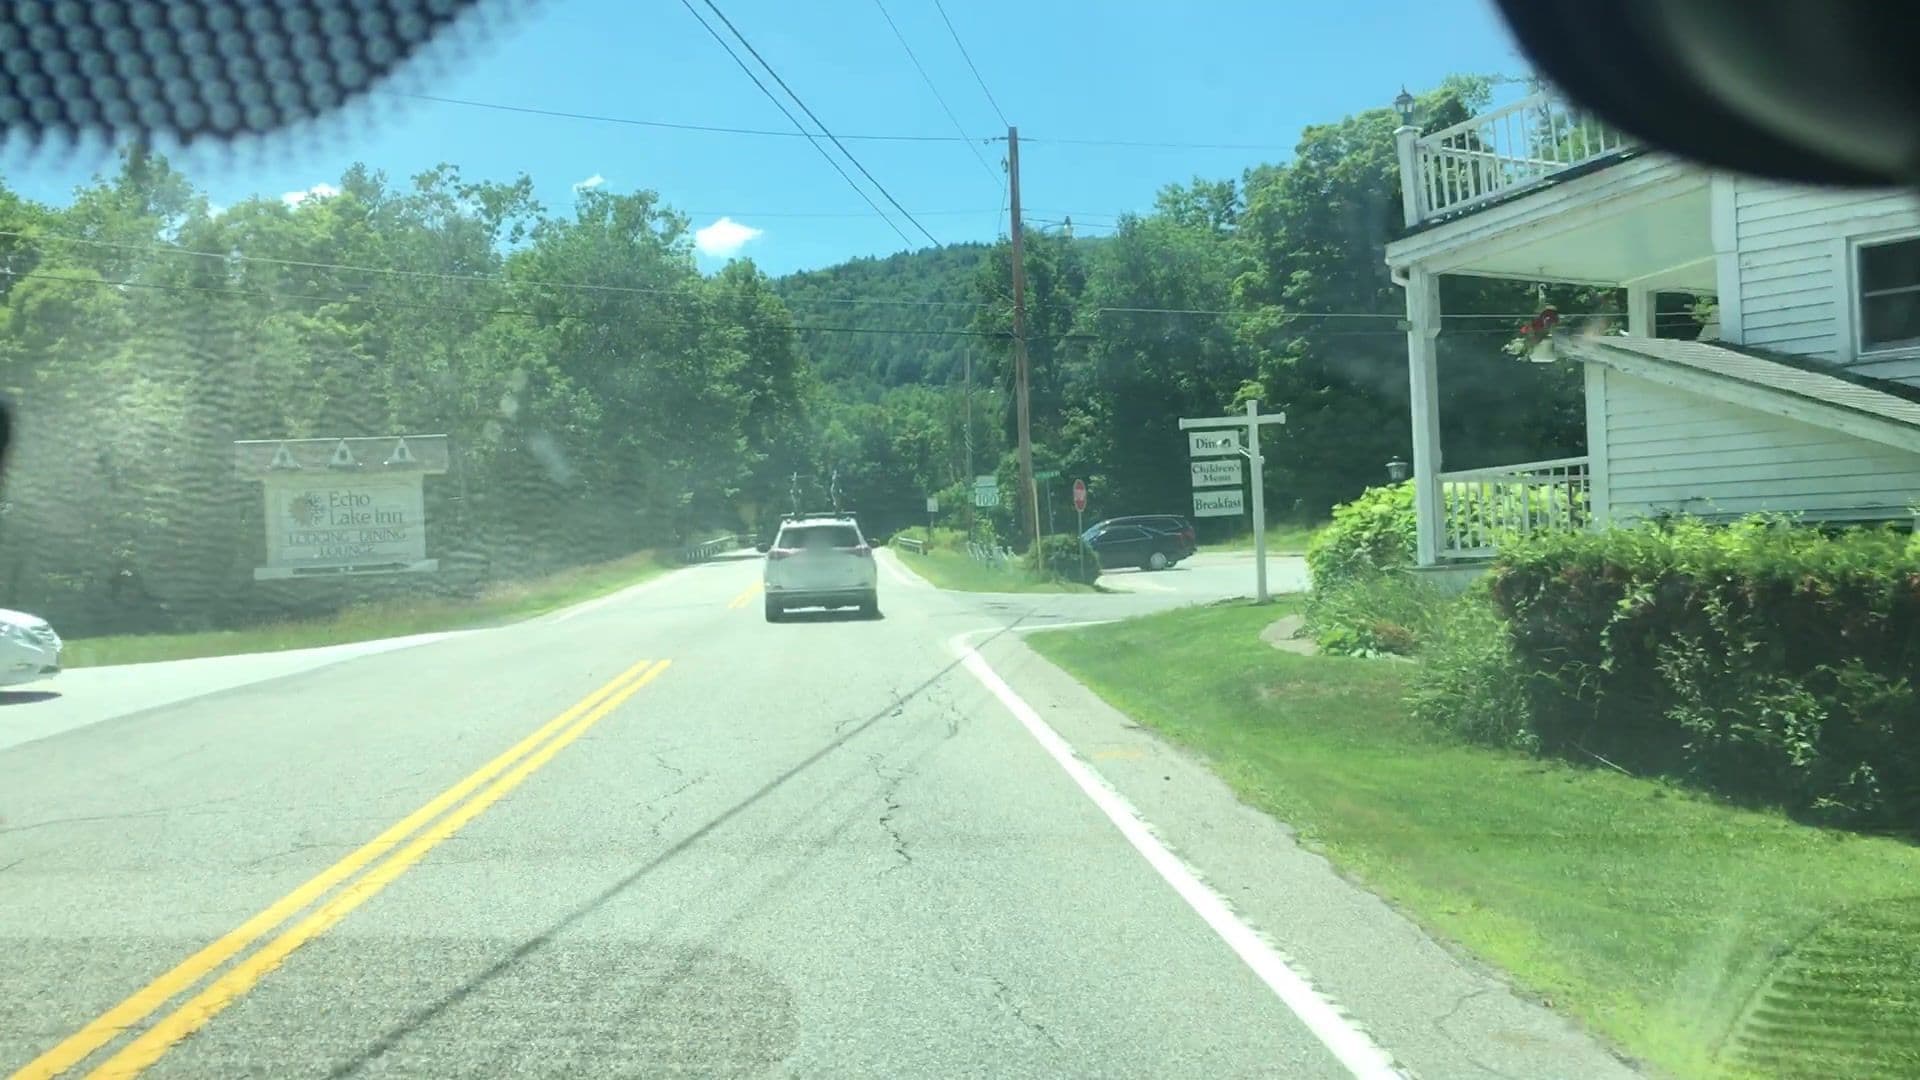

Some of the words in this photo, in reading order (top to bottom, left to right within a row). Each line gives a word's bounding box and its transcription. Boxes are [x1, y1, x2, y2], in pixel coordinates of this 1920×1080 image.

[1192, 463, 1240, 474] Children's
[1203, 474, 1231, 482] Menu
[329, 490, 371, 508] Echo
[979, 494, 998, 505] 100
[1195, 496, 1241, 510] Breakfast
[330, 508, 371, 526] Lake
[359, 528, 408, 543] DINING
